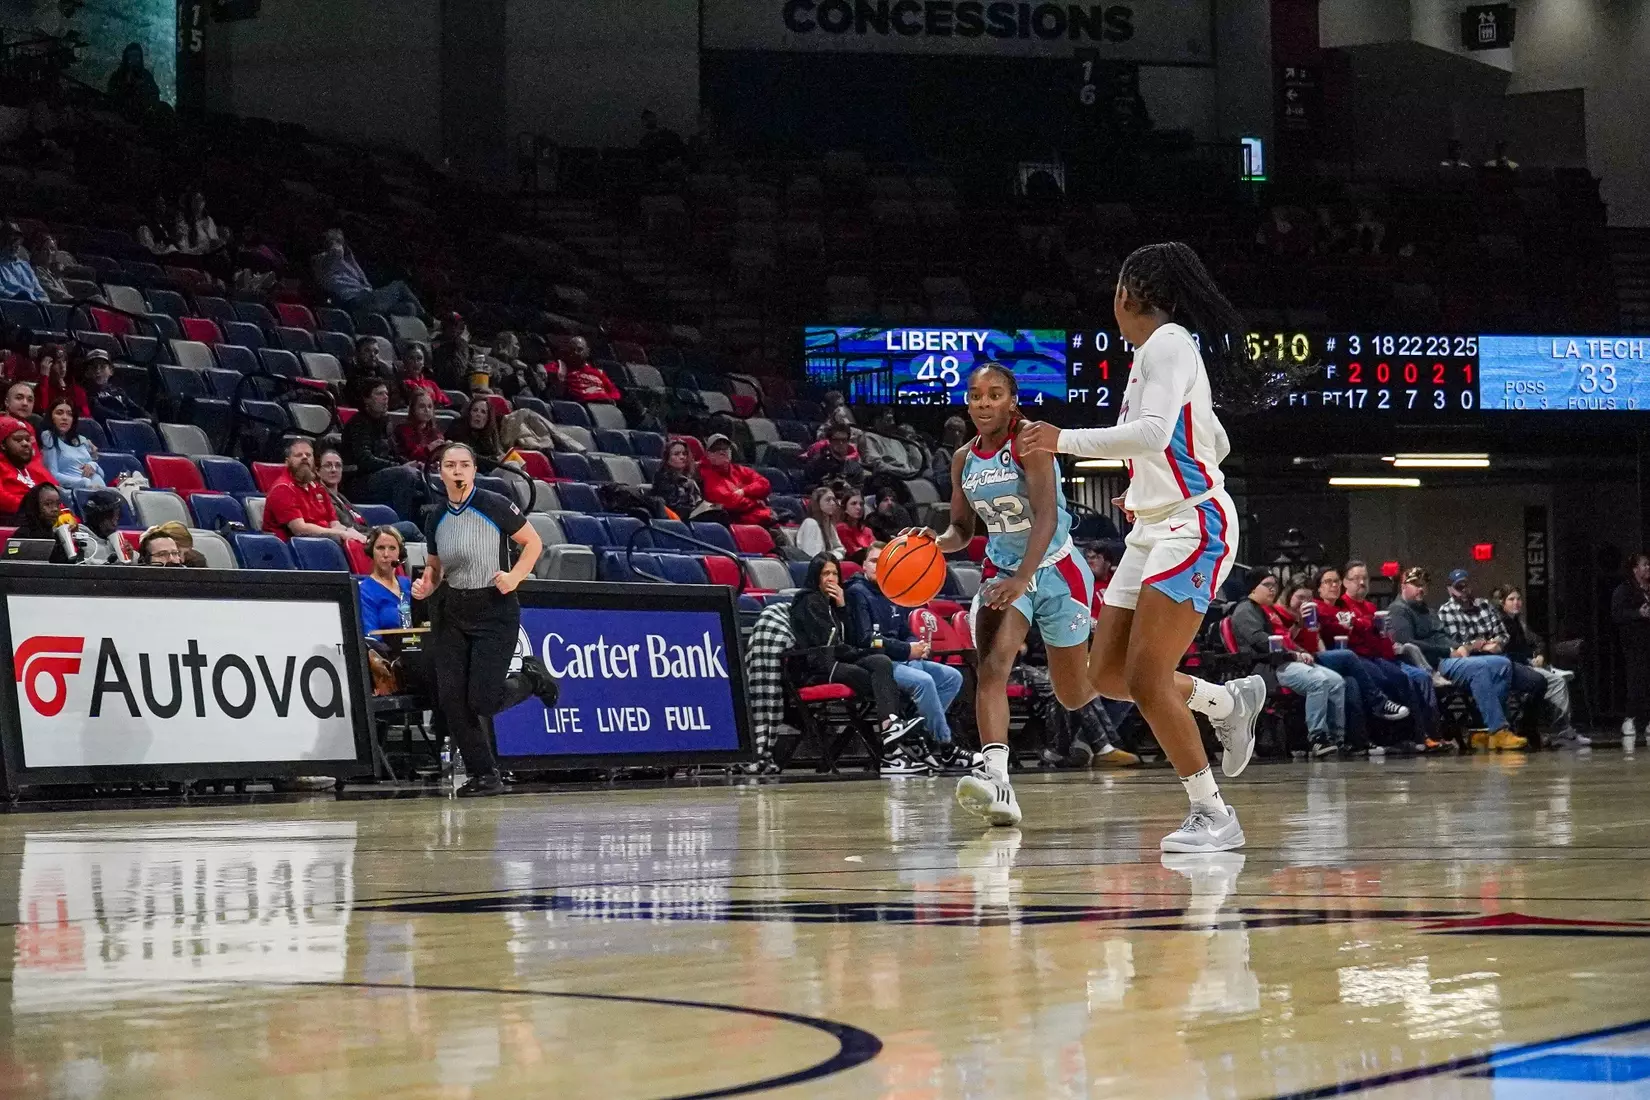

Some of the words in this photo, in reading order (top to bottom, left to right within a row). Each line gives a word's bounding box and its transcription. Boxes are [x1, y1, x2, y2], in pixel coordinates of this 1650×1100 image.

[783, 0, 1134, 42] CONCESSIONS
[886, 330, 989, 351] LIBERTY
[1095, 332, 1109, 352] 0
[1348, 335, 1361, 356] 3
[1371, 335, 1395, 356] 18
[1398, 336, 1423, 356] 22
[1426, 336, 1450, 356] 23
[1453, 337, 1478, 357] 25
[1551, 339, 1581, 358] LA
[1585, 339, 1643, 359] TECH
[916, 355, 961, 388] 48
[1072, 362, 1083, 377] F
[1098, 359, 1109, 380] 1
[1326, 365, 1337, 380] F
[1348, 362, 1362, 384] 2
[1376, 362, 1390, 384] 0
[1404, 362, 1418, 384] 0
[1432, 362, 1445, 384] 2
[1462, 363, 1472, 384] 1
[1578, 363, 1618, 394] 33
[1068, 389, 1089, 403] PT
[1096, 386, 1110, 407] 2
[1504, 380, 1547, 395] POSS
[1034, 392, 1044, 406] 4
[1322, 391, 1342, 406] PT
[1344, 388, 1368, 409] 17
[1377, 389, 1390, 409] 2
[1405, 389, 1418, 409] 7
[1433, 390, 1445, 410] 3
[1460, 390, 1473, 410] 0
[1539, 397, 1548, 410] 3
[1568, 397, 1616, 410] FOULS
[973, 495, 1032, 533] 22
[1526, 530, 1545, 587] MEN
[542, 632, 640, 680] Carter
[645, 630, 730, 679] Bank
[89, 637, 346, 720] Autova
[543, 708, 583, 734] LIFE
[597, 707, 651, 732] LIVED
[665, 706, 711, 731] FULL
